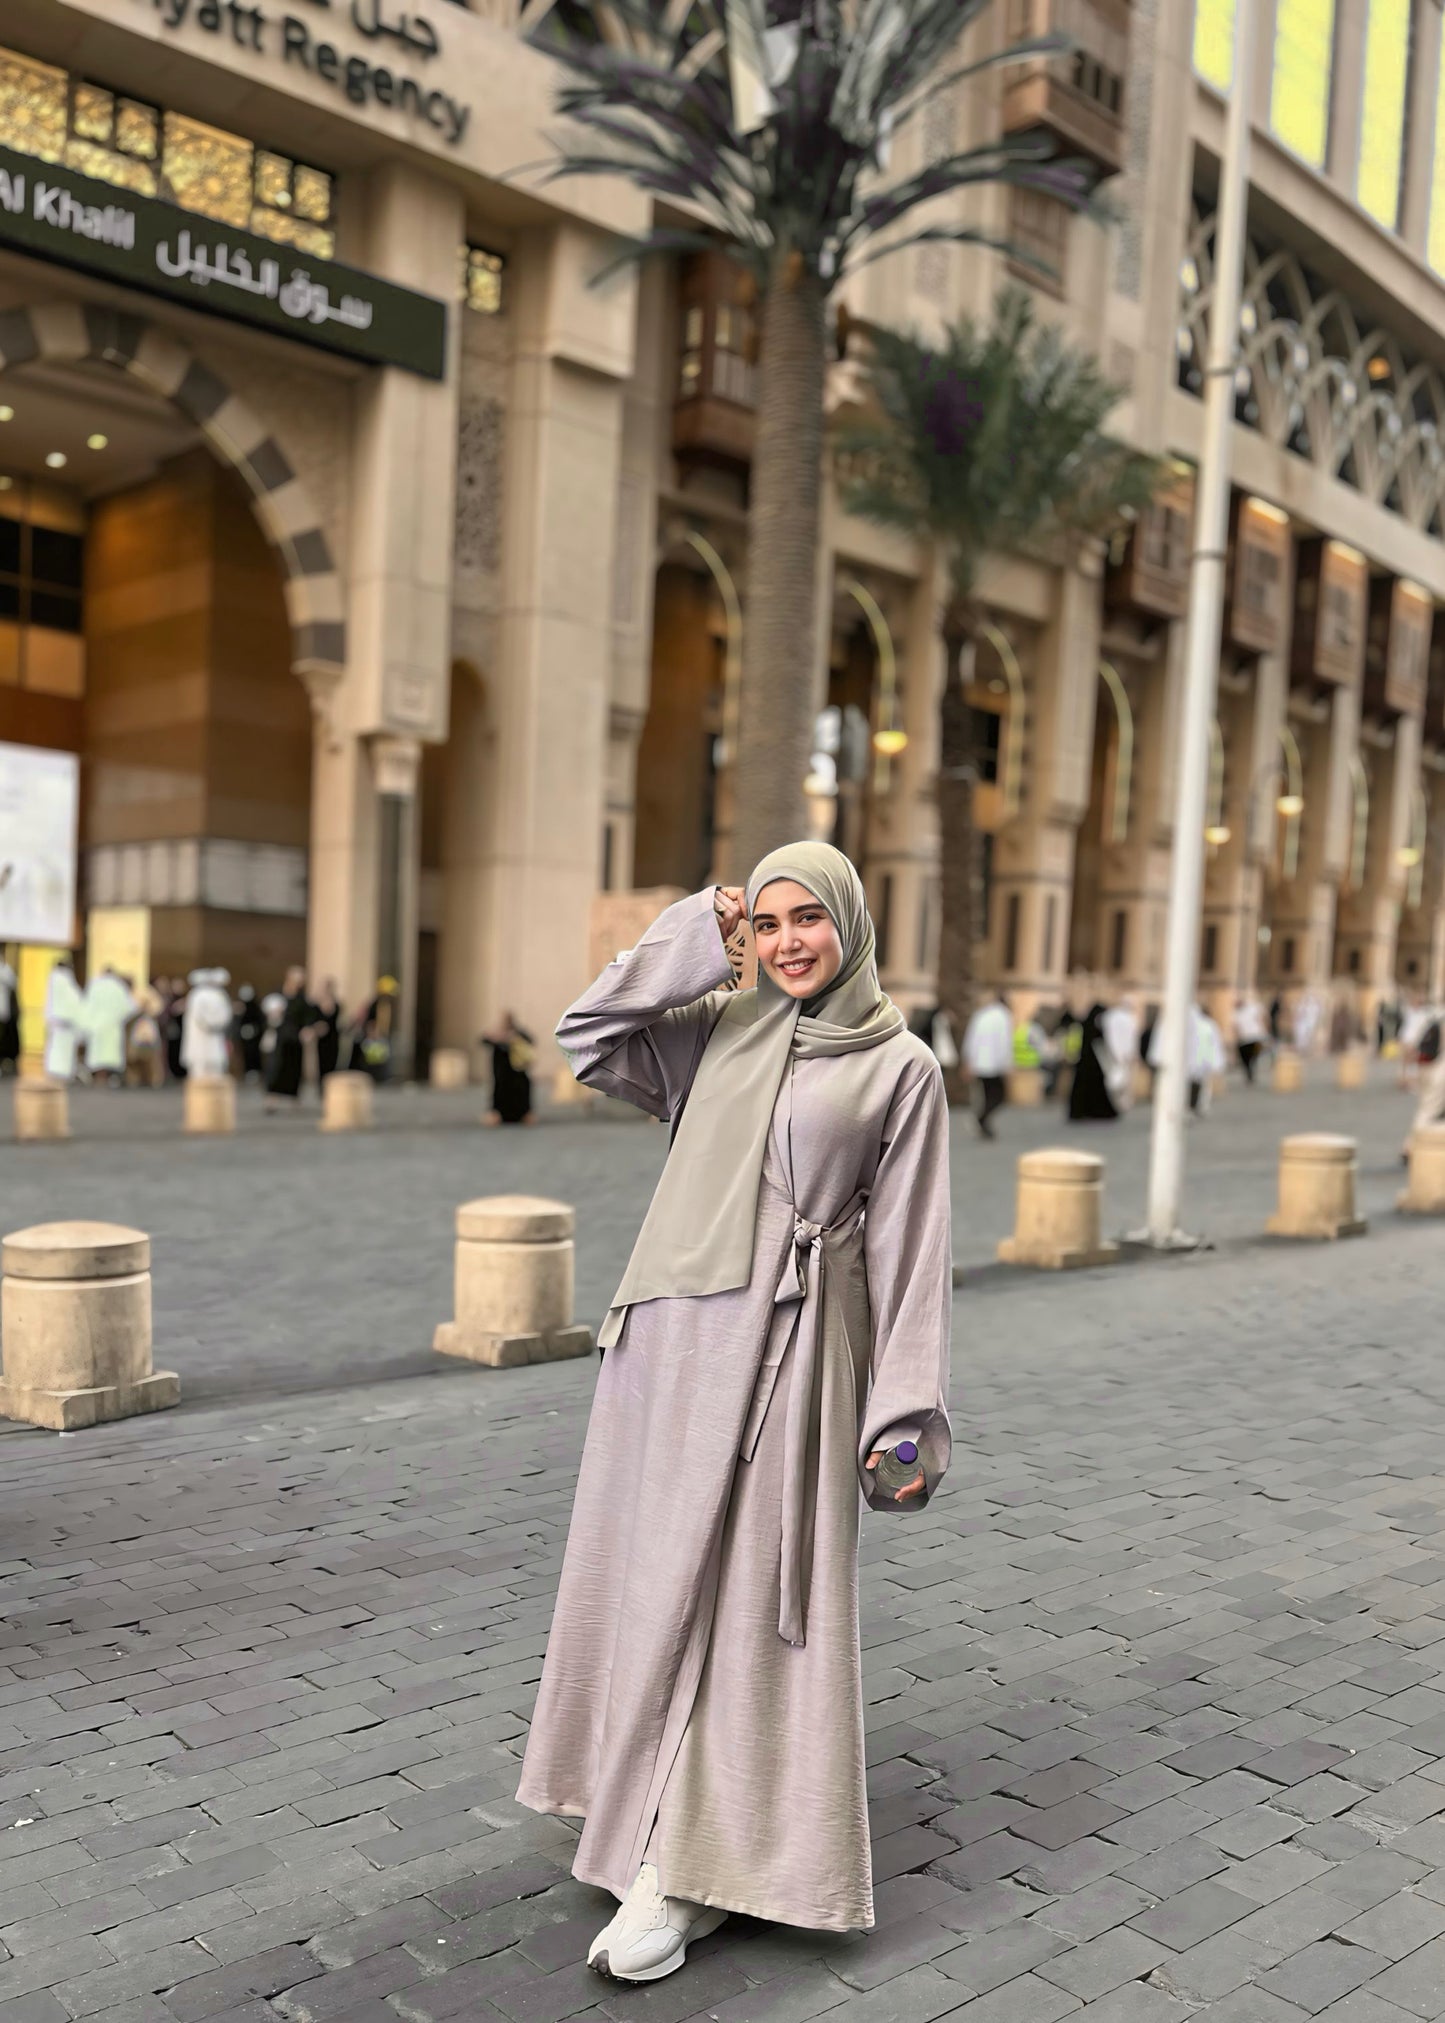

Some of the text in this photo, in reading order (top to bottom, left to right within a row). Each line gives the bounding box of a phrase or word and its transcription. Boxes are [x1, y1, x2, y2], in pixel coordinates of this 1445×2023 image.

[153, 0, 470, 144] yatt Regency
[155, 229, 373, 330] سوق الخليل
